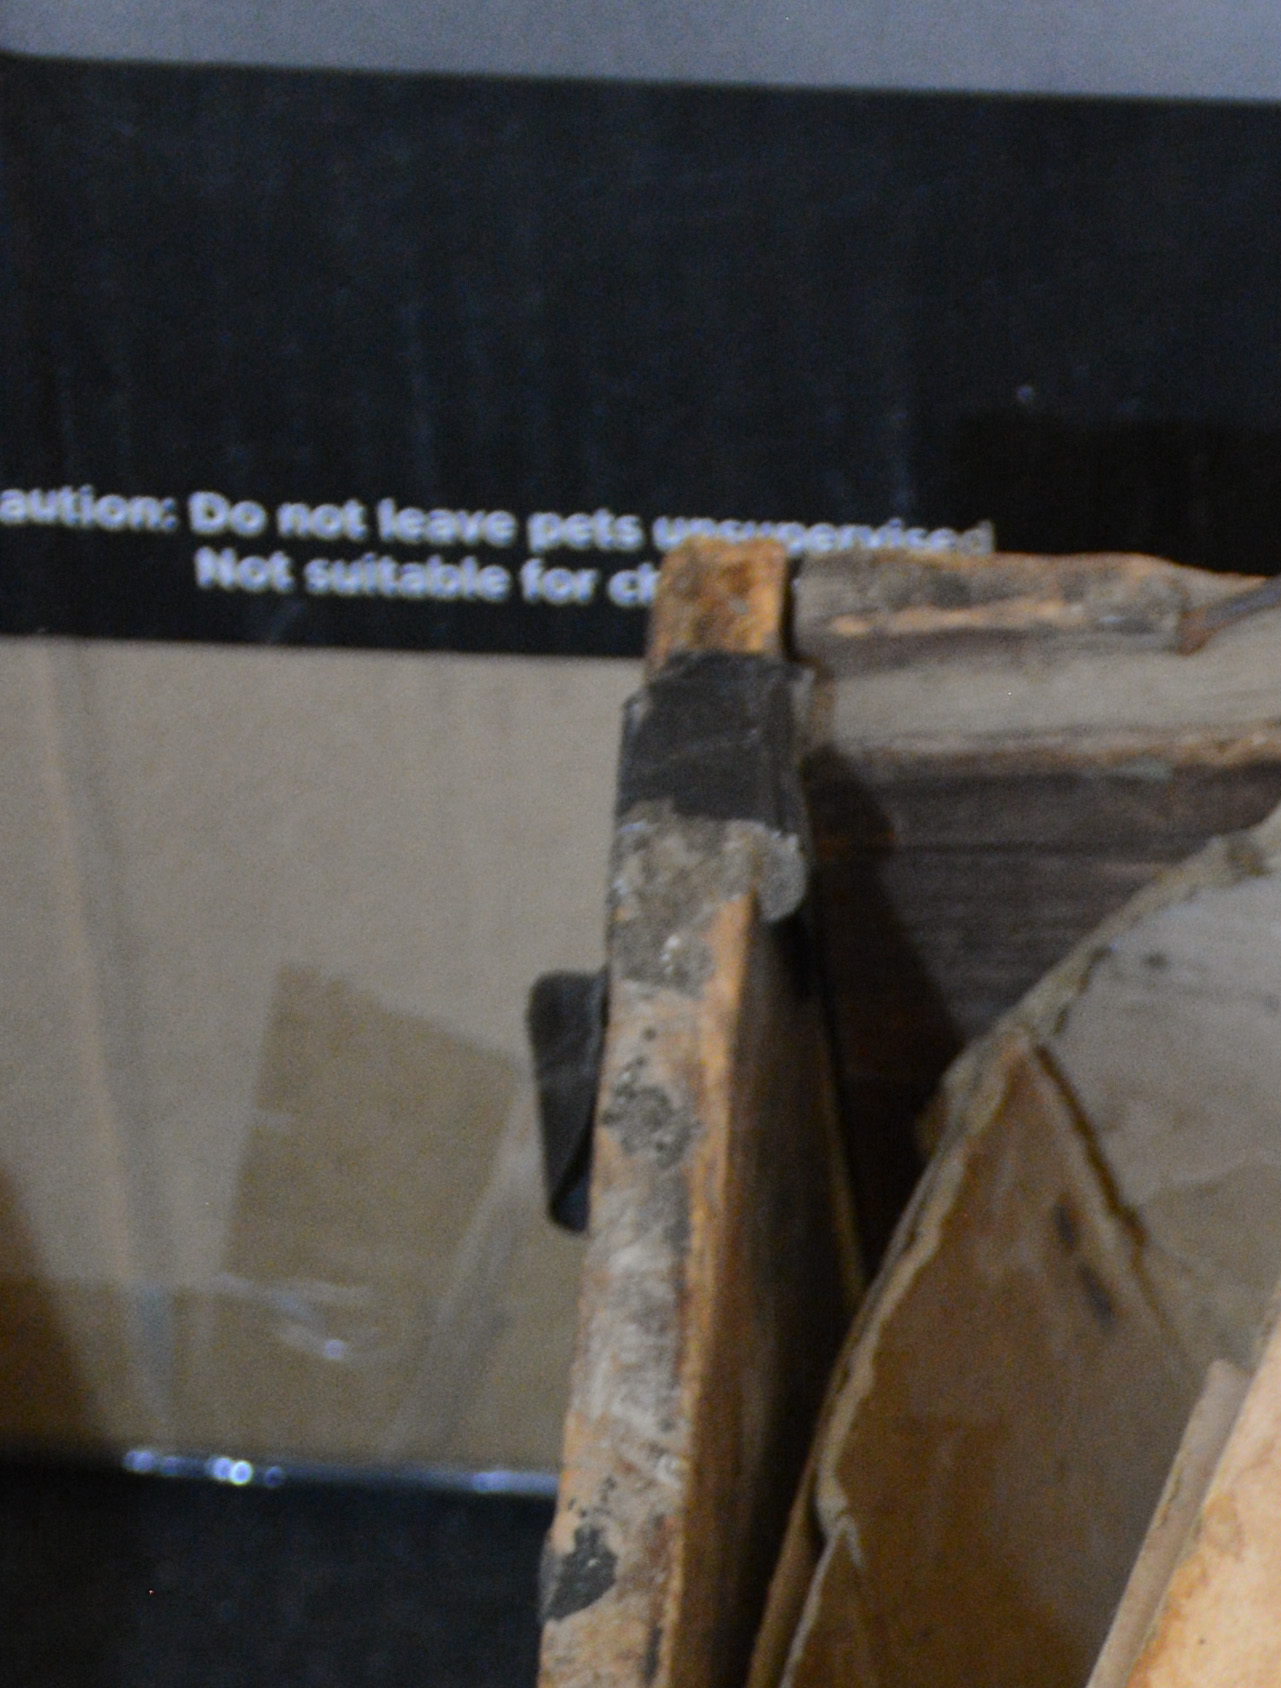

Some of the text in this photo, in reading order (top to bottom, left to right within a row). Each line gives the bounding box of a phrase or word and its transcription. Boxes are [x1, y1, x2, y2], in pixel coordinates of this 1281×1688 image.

[0, 484, 178, 532] aution:
[187, 490, 267, 537] Do
[277, 500, 367, 542] not
[377, 498, 517, 546] leave
[526, 508, 644, 553] pets
[194, 546, 295, 594] Not
[303, 552, 511, 600] suitable
[520, 558, 598, 603] for
